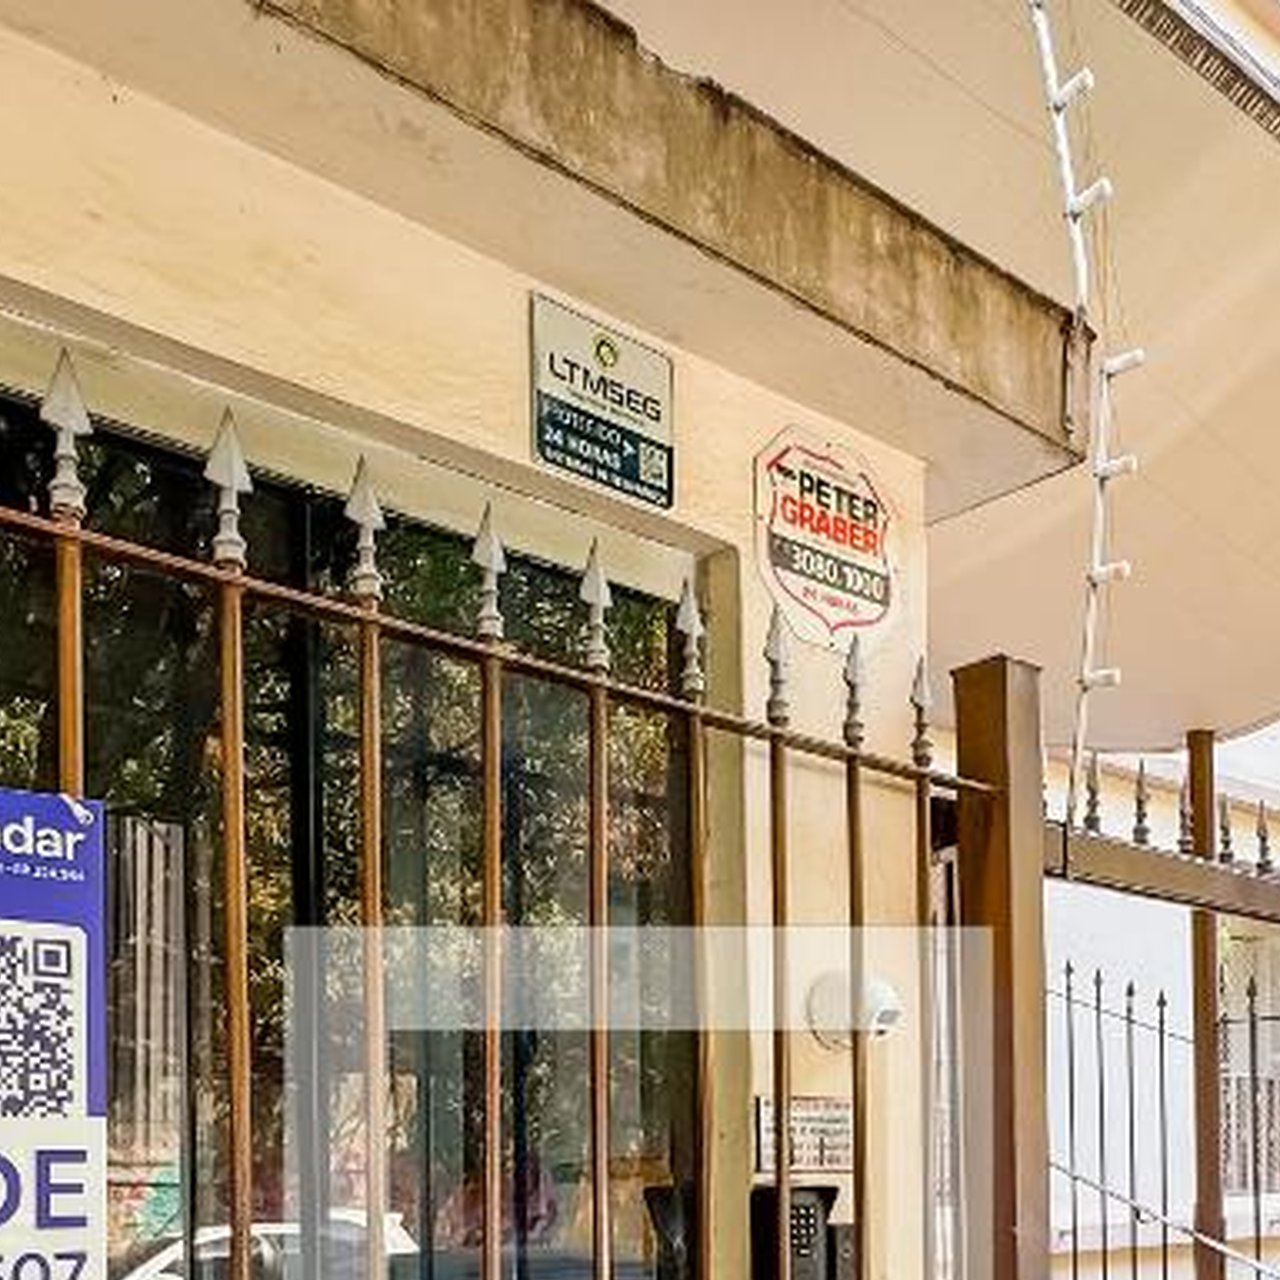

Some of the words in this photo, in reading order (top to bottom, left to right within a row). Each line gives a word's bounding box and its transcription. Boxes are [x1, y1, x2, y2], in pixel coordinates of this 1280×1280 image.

[549, 352, 661, 422] LTMSEG
[780, 495, 878, 557] GRABER
[799, 469, 878, 531] PETER
